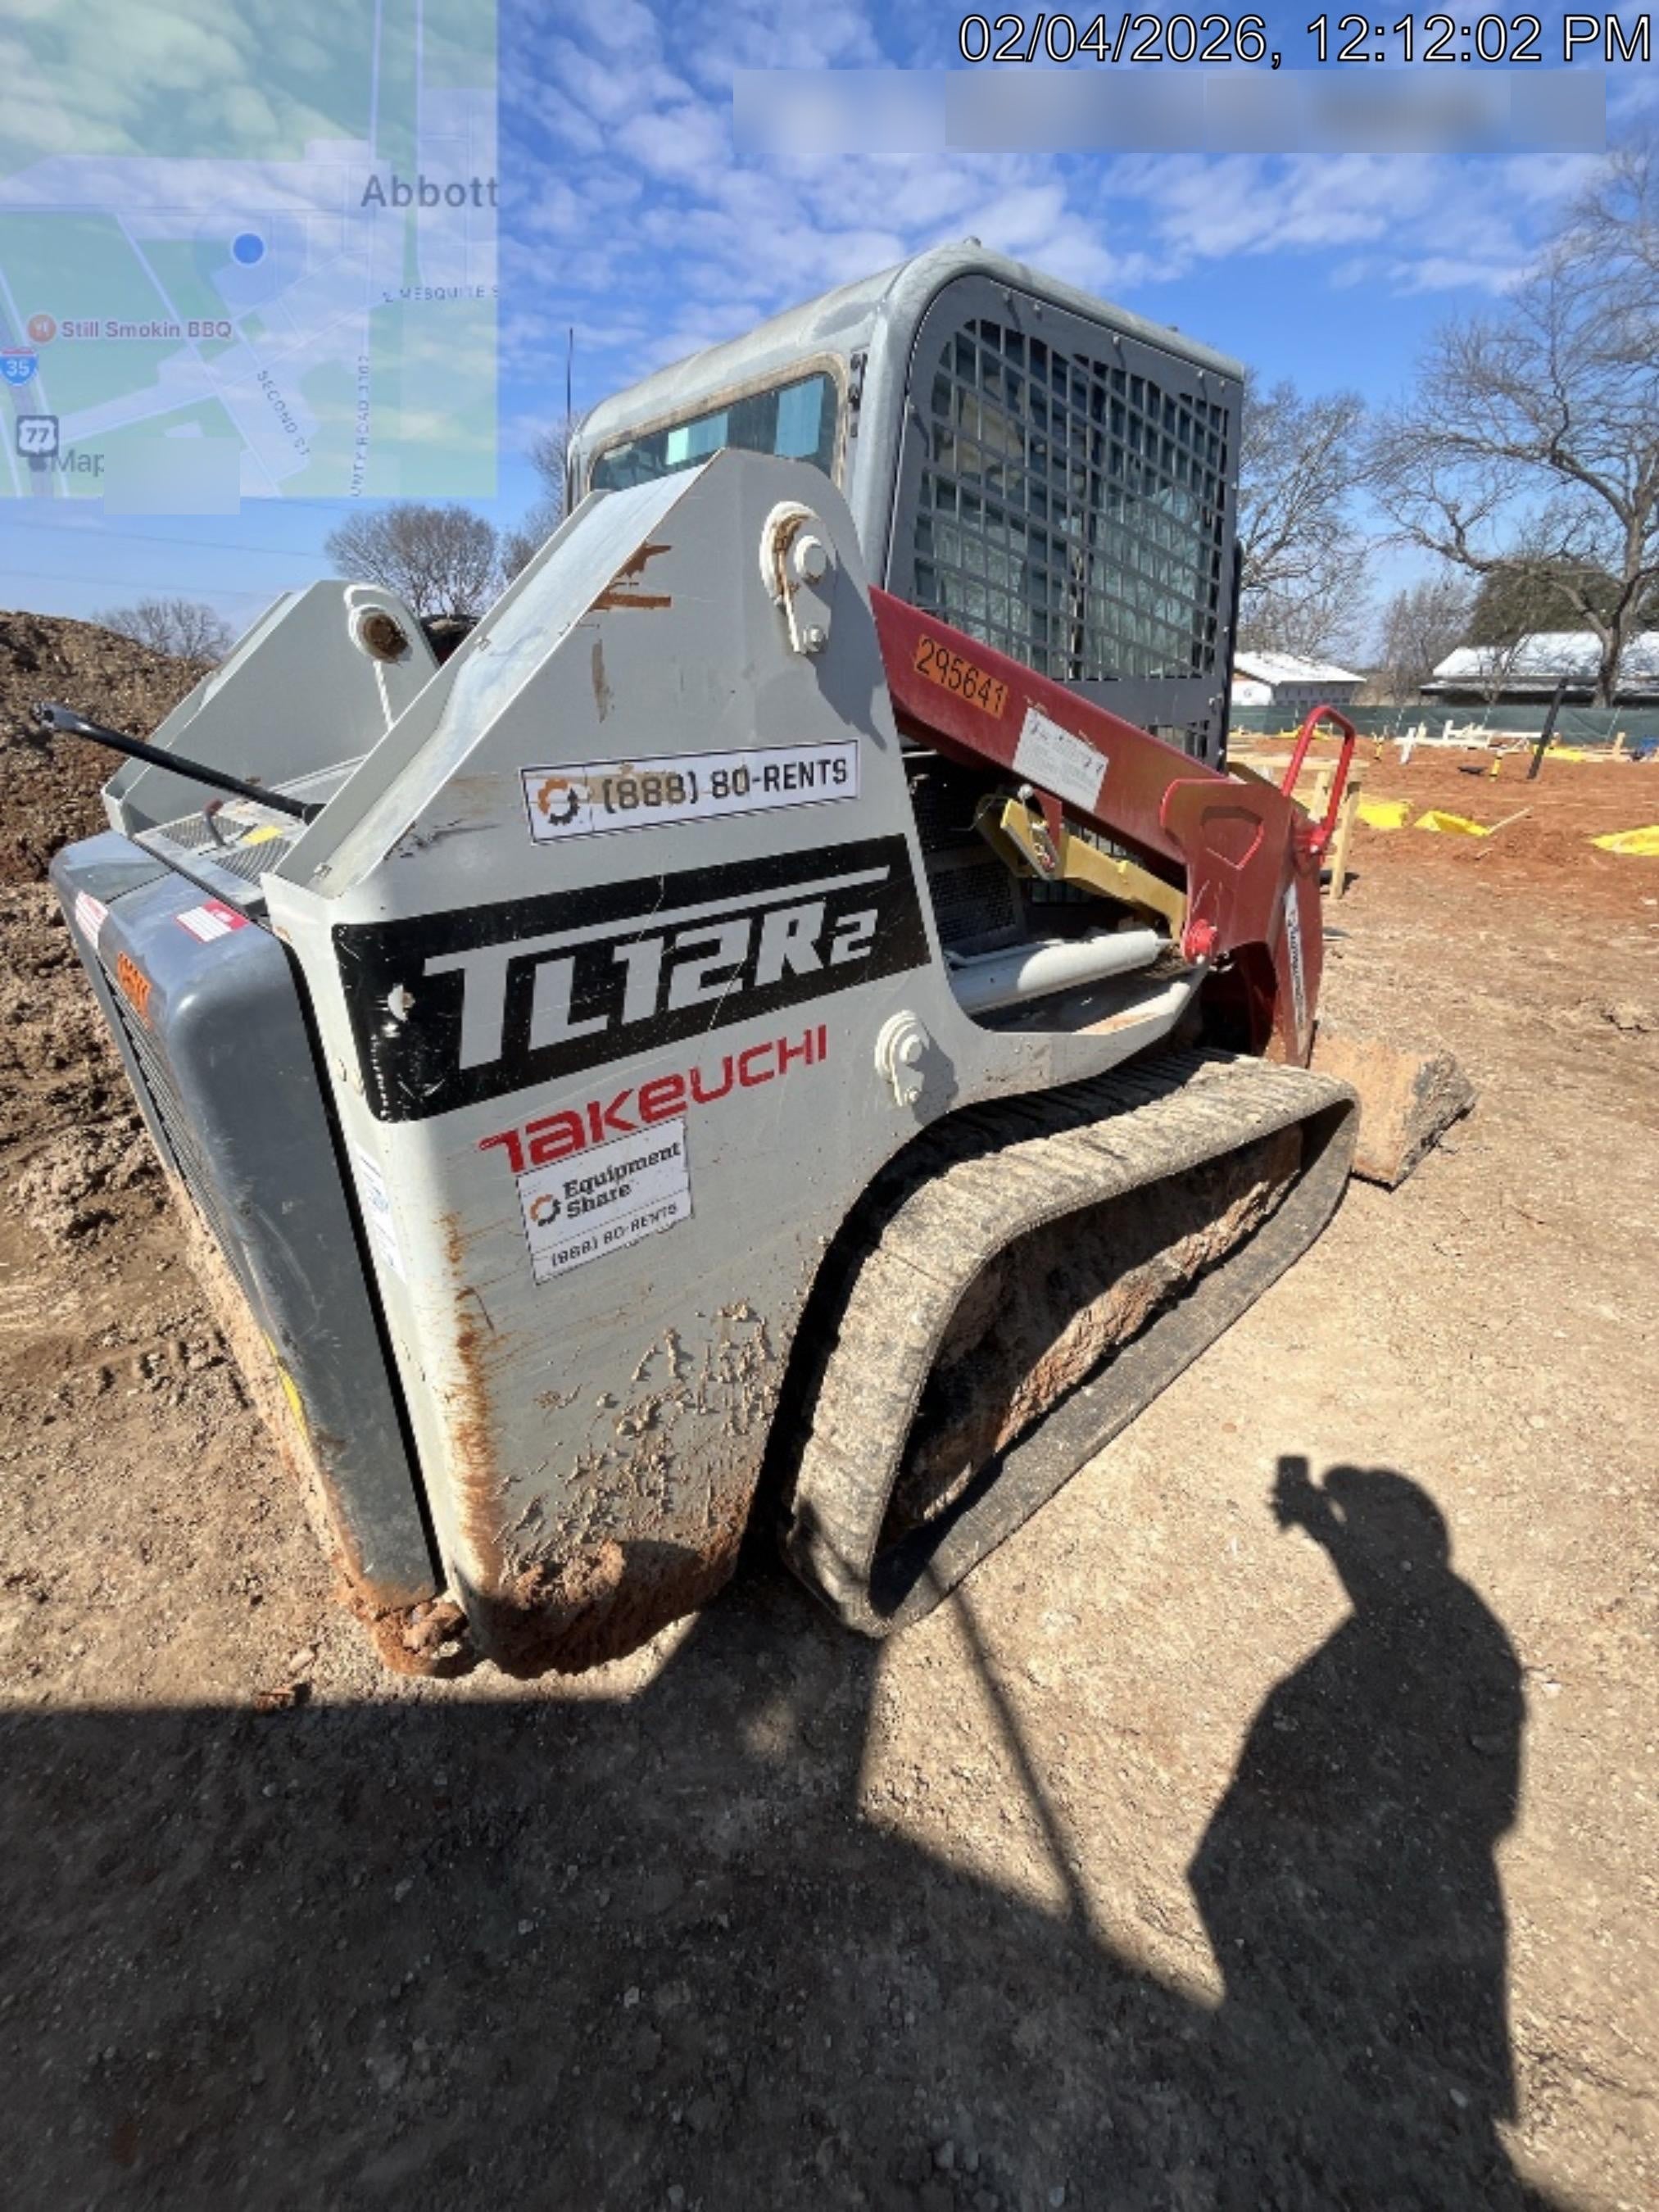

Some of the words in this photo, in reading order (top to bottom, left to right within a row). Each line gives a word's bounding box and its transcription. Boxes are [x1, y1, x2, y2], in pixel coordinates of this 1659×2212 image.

[917, 639, 1004, 713] 295641
[601, 769, 699, 814] (888)
[709, 758, 848, 800] 80-RENTS
[424, 866, 891, 1070] TL12R2
[563, 1142, 681, 1200] Equipment
[567, 1184, 632, 1219] Share
